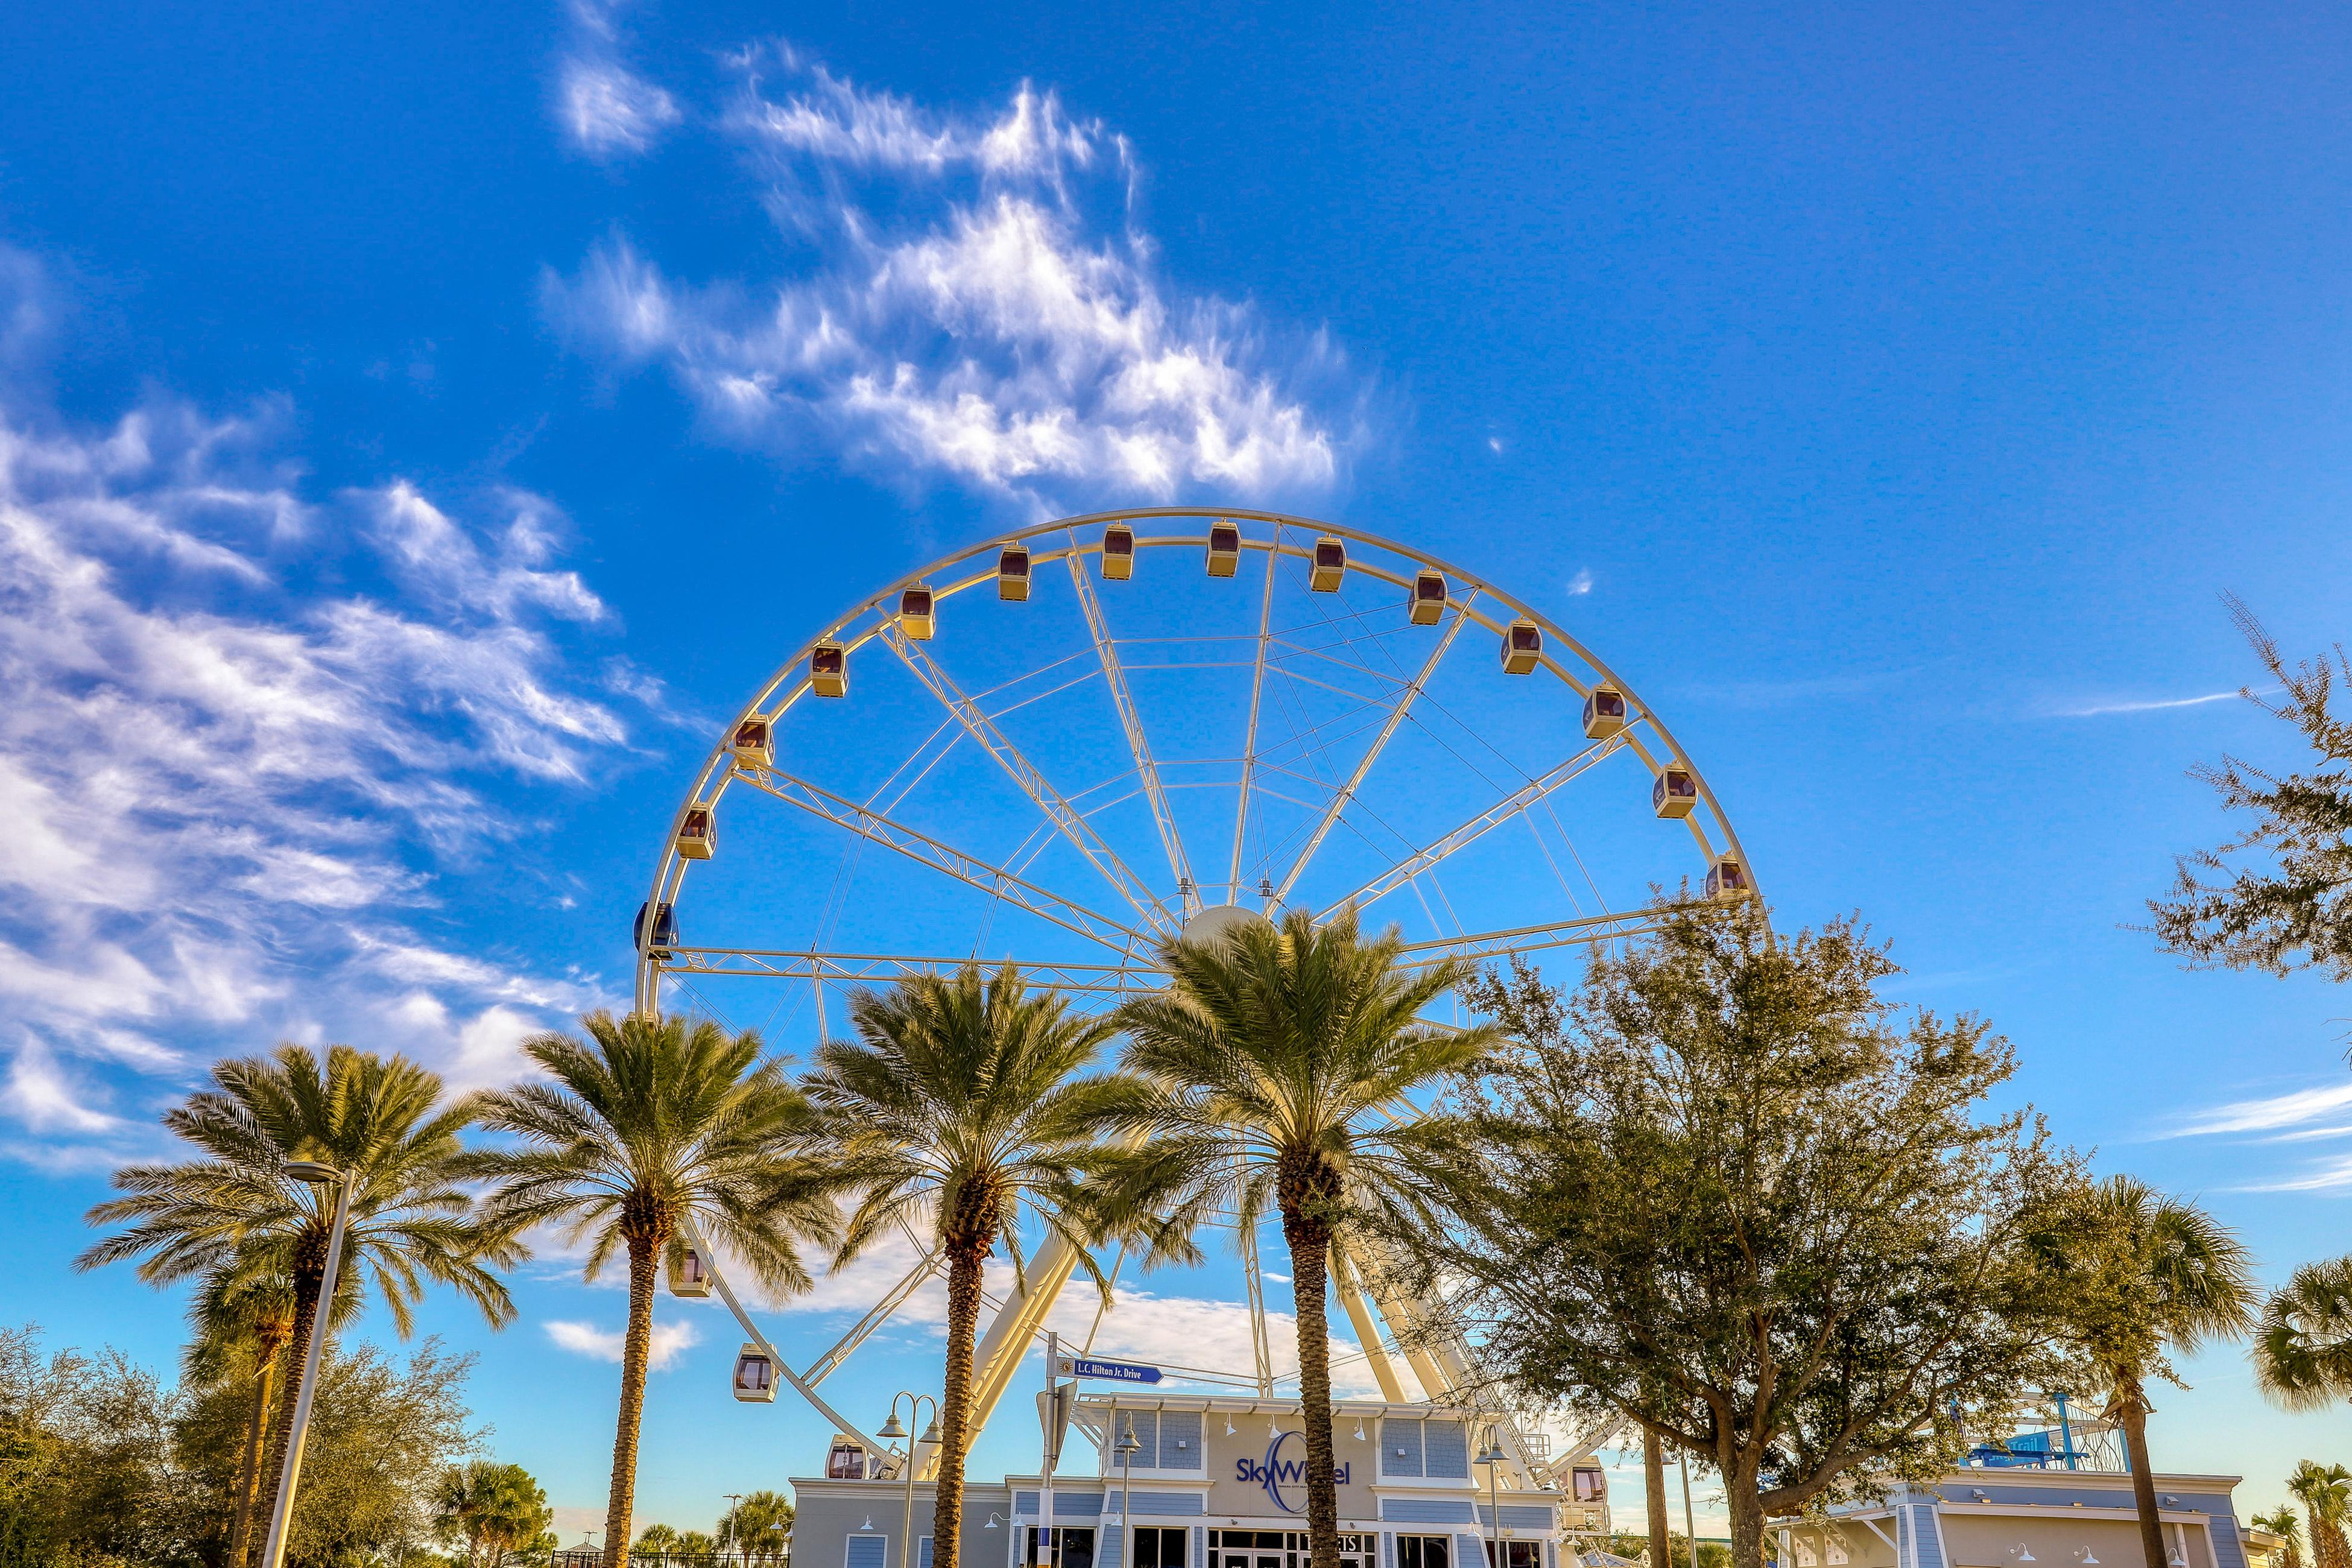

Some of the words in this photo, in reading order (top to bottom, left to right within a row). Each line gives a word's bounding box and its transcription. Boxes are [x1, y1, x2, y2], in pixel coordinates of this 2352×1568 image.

[1078, 1363, 1090, 1373] L.C.
[1092, 1364, 1113, 1376] Hilton
[1114, 1368, 1122, 1377] Jr.
[1124, 1368, 1141, 1379] Drive
[2011, 1437, 2038, 1452] Trail
[1236, 1458, 1350, 1489] SkyWel
